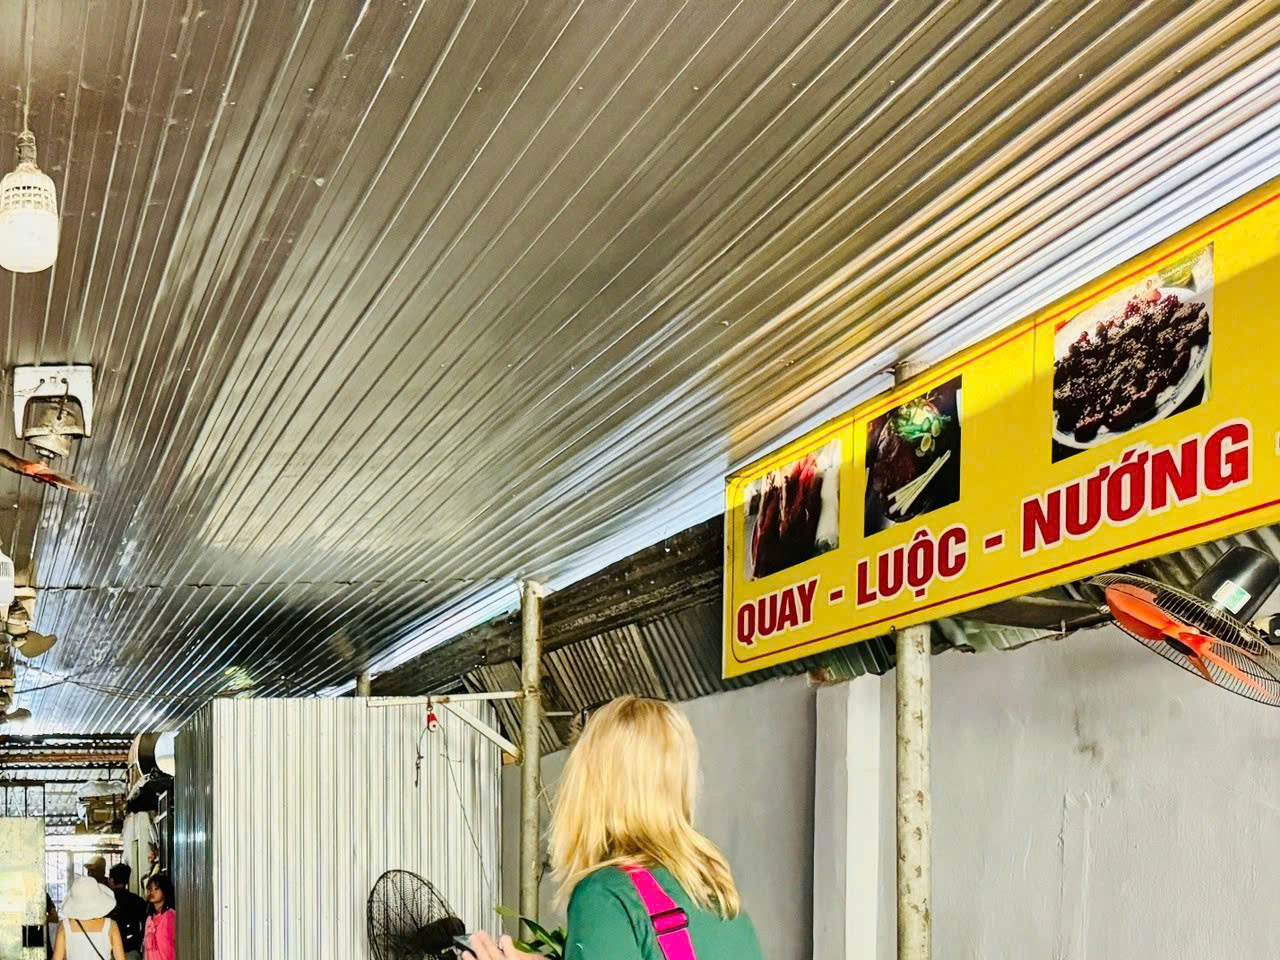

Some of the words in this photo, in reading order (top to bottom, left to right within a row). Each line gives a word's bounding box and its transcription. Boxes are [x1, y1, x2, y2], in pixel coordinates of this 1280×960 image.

[737, 581, 818, 644] QUAY
[856, 527, 966, 606] LUỘC
[1022, 423, 1250, 553] NƯỚNG
